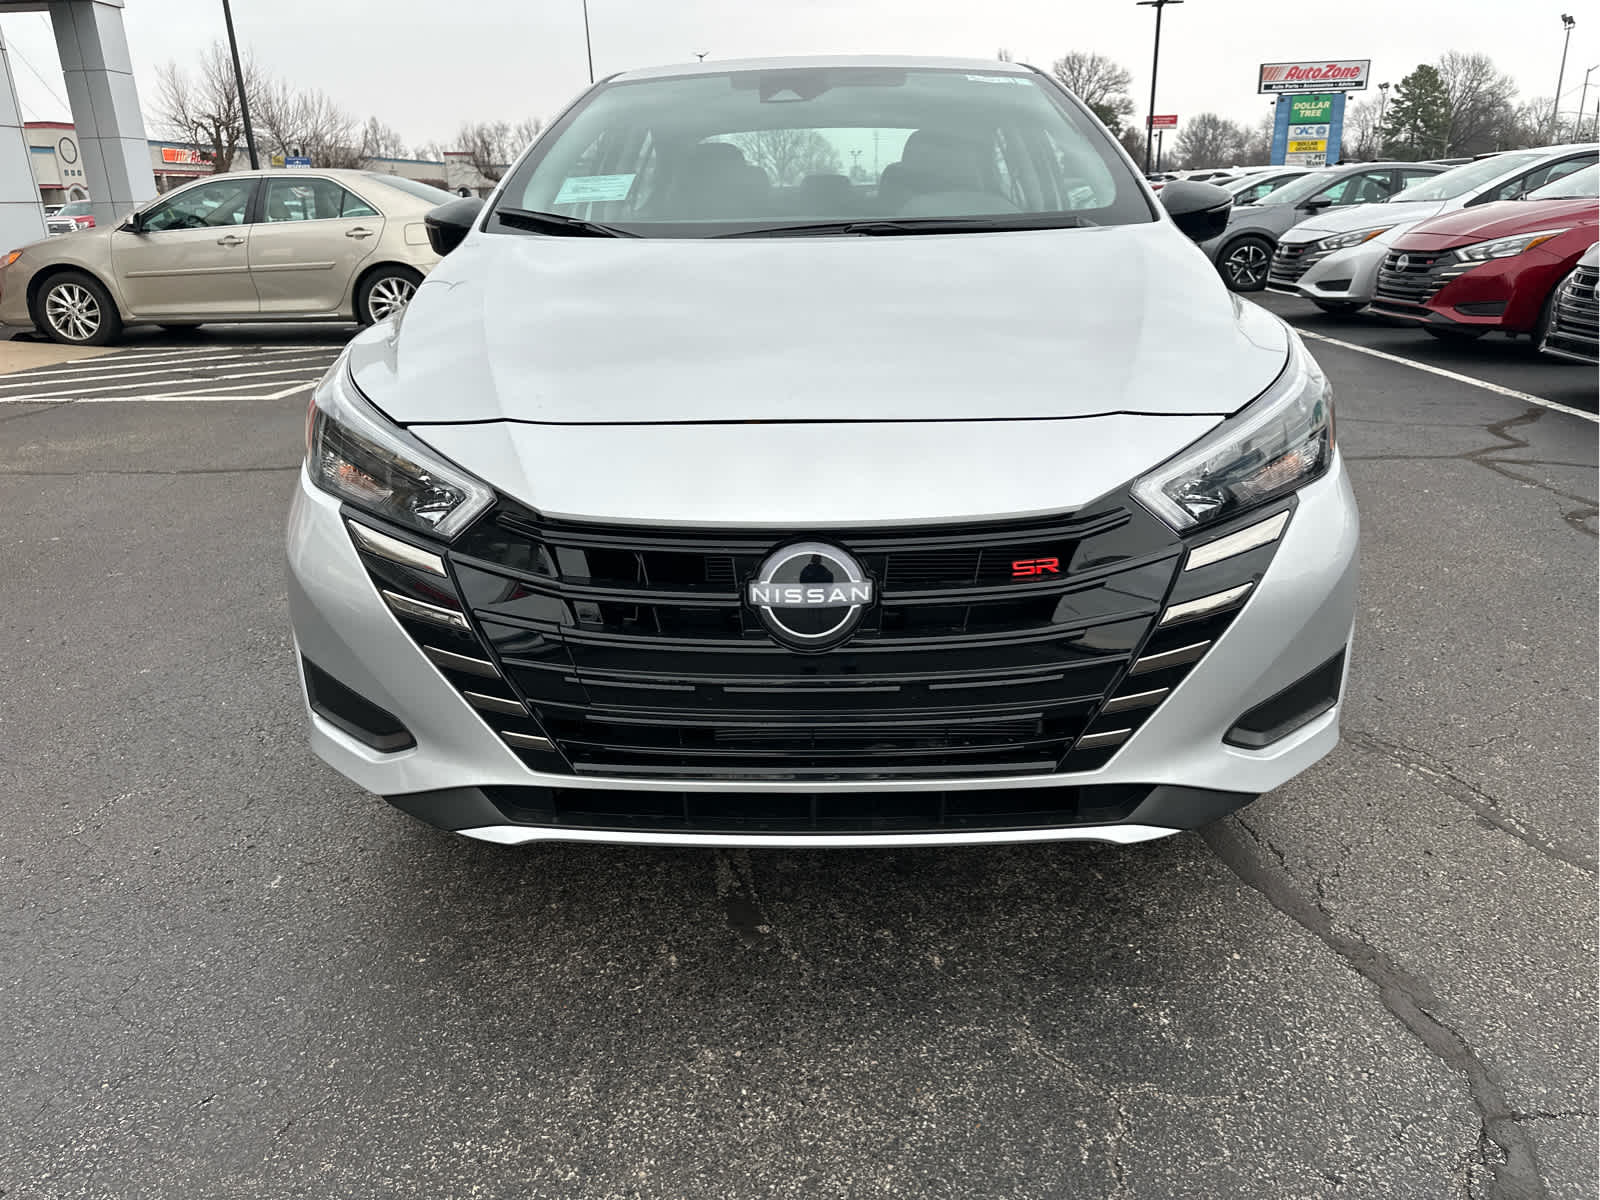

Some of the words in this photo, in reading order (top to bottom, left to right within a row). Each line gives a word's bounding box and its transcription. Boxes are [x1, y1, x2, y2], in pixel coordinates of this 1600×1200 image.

[1284, 64, 1361, 80] AutoZone
[1294, 101, 1331, 110] DOLLAR
[1299, 109, 1323, 118] TREE
[1012, 557, 1060, 576] SR
[752, 587, 869, 603] NISSAN
